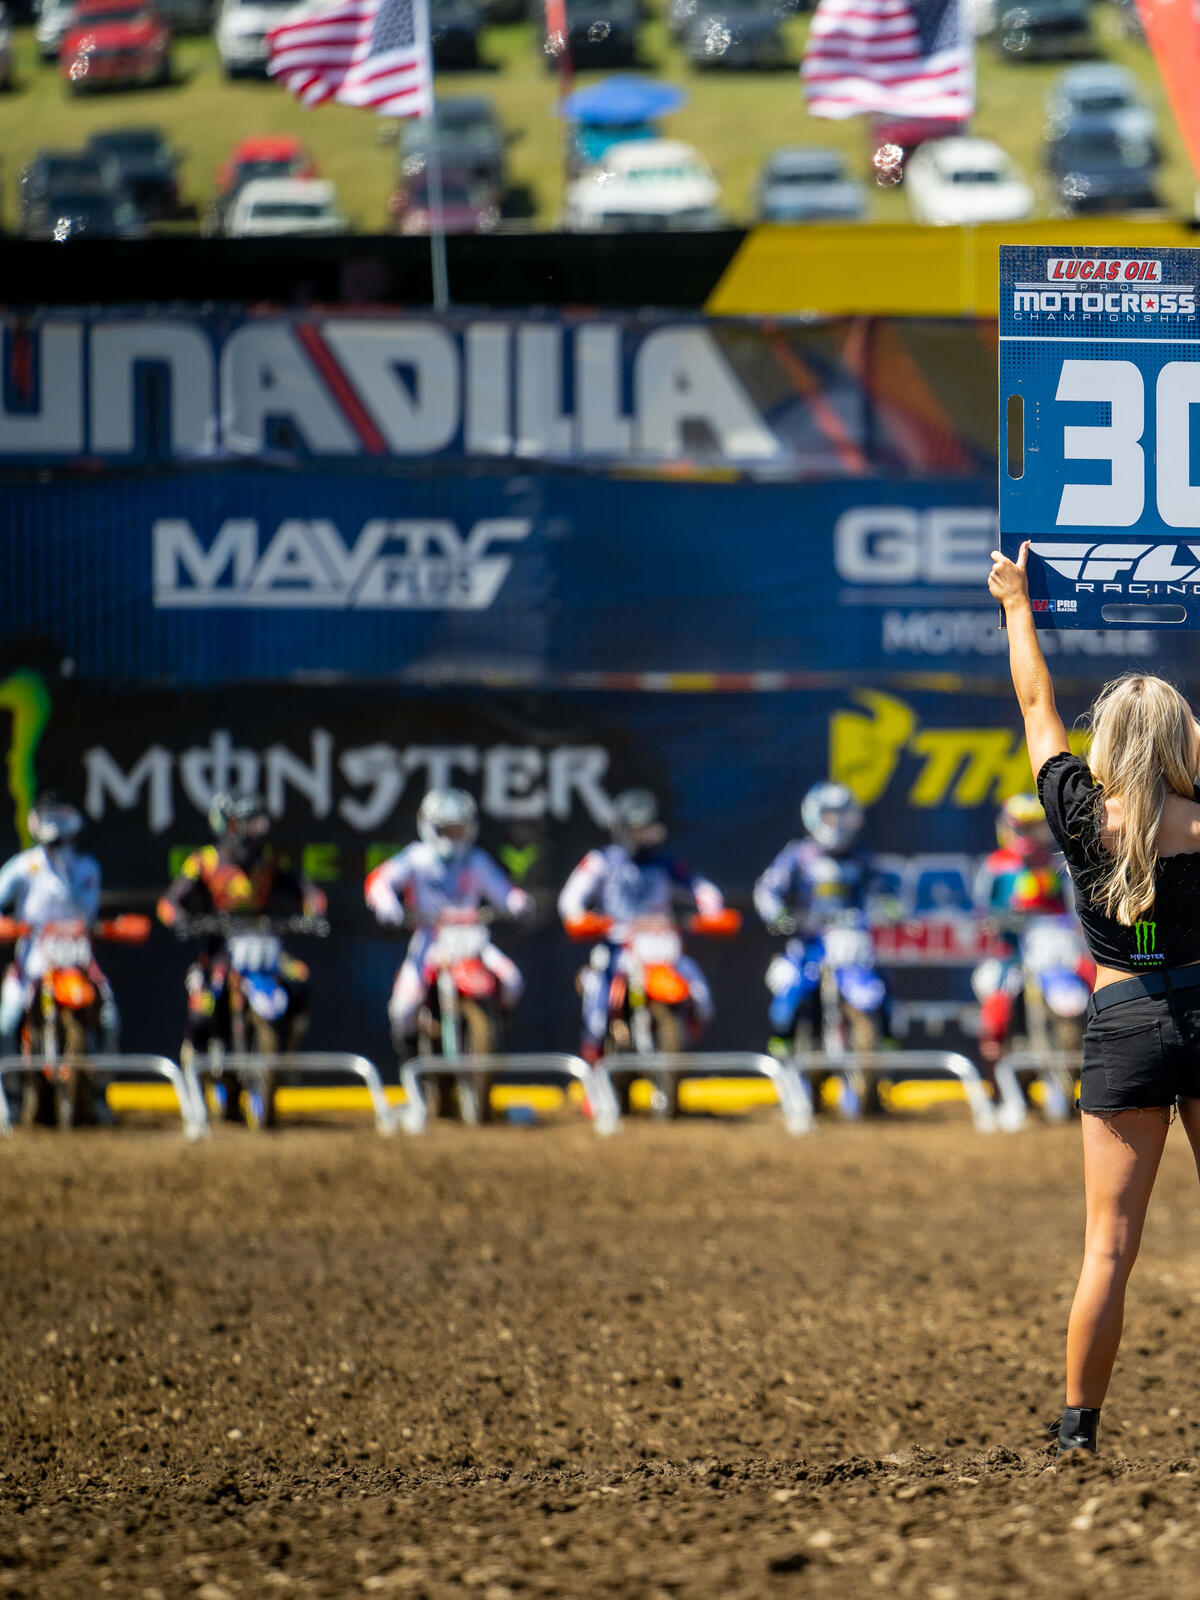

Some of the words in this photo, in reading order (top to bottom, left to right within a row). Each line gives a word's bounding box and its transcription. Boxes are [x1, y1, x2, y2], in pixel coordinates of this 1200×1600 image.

[1052, 261, 1121, 281] LUCAS
[1124, 261, 1159, 281] OIL
[1080, 284, 1129, 292] PRO
[1013, 292, 1196, 314] MOTOCROSS
[1013, 313, 1197, 323] CHAMPIONSHIP
[84, 729, 622, 834] MONSTER
[1130, 953, 1165, 961] MONSTER
